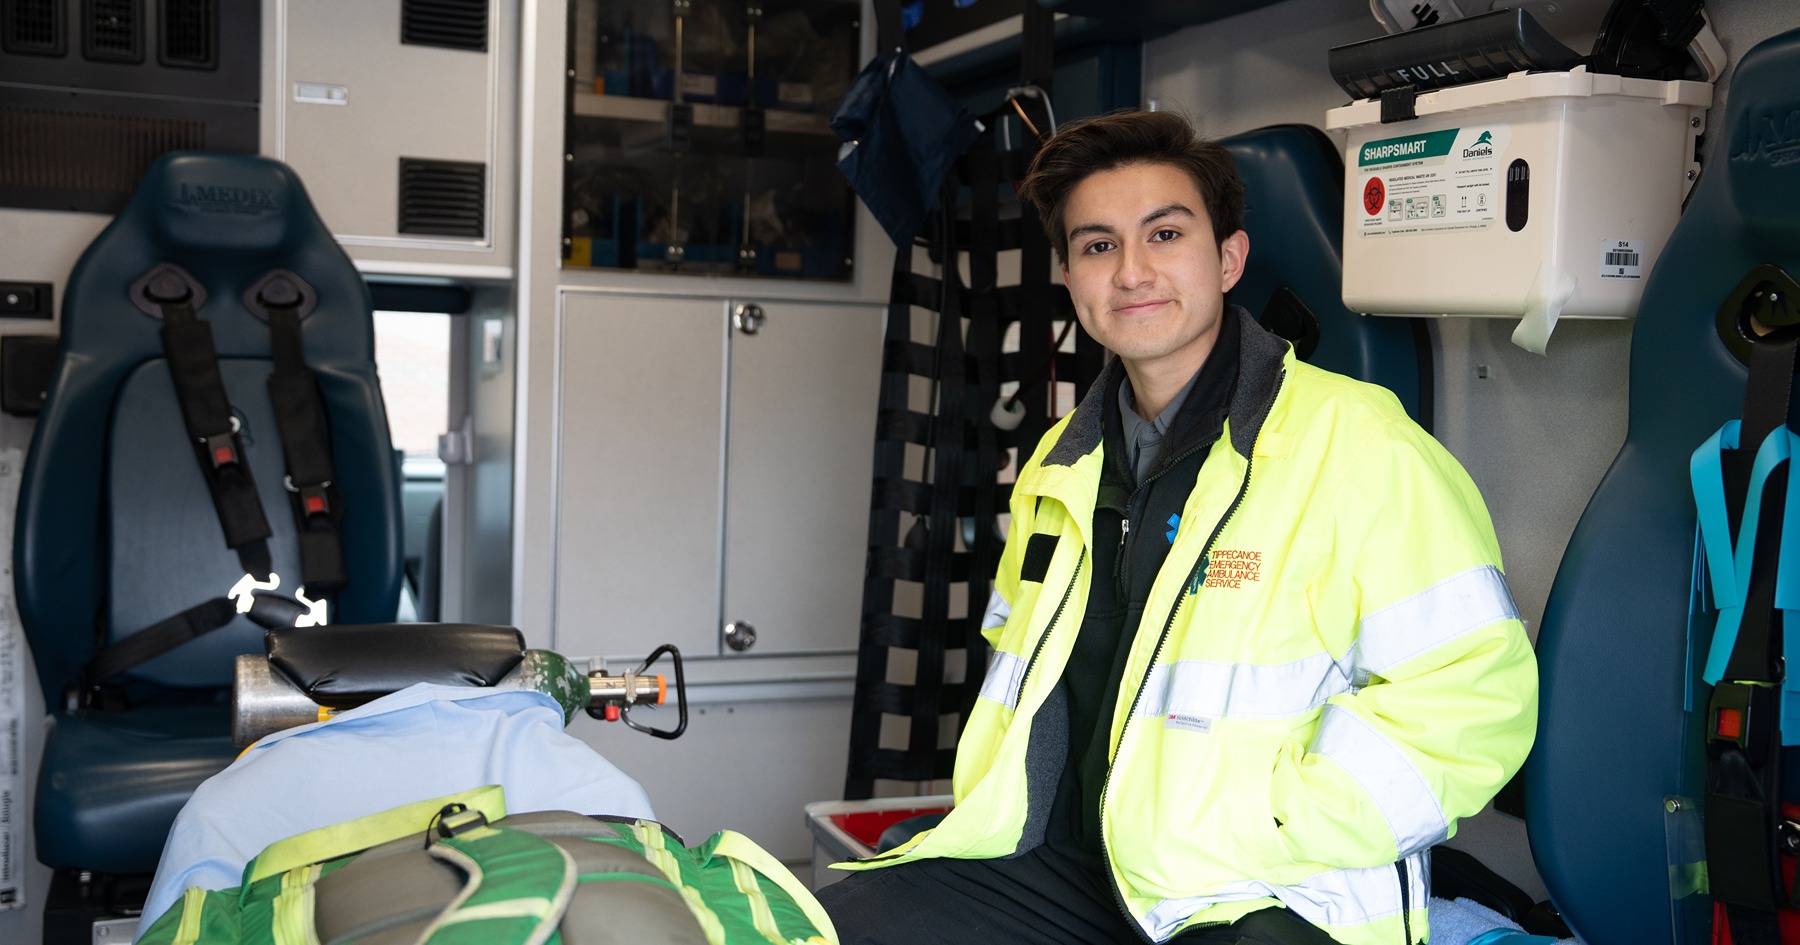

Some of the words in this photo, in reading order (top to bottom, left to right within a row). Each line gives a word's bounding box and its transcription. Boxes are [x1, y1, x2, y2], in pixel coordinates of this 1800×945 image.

[1396, 62, 1460, 82] FULL
[1364, 140, 1427, 160] SHARPSMART
[1462, 146, 1492, 158] Daniels
[196, 185, 278, 208] MEDIX
[1212, 550, 1262, 561] TIPPECANOE
[1209, 560, 1261, 571] EMERGENCY
[1206, 569, 1260, 581] AMBULANCE
[1205, 579, 1241, 589] SERVICE
